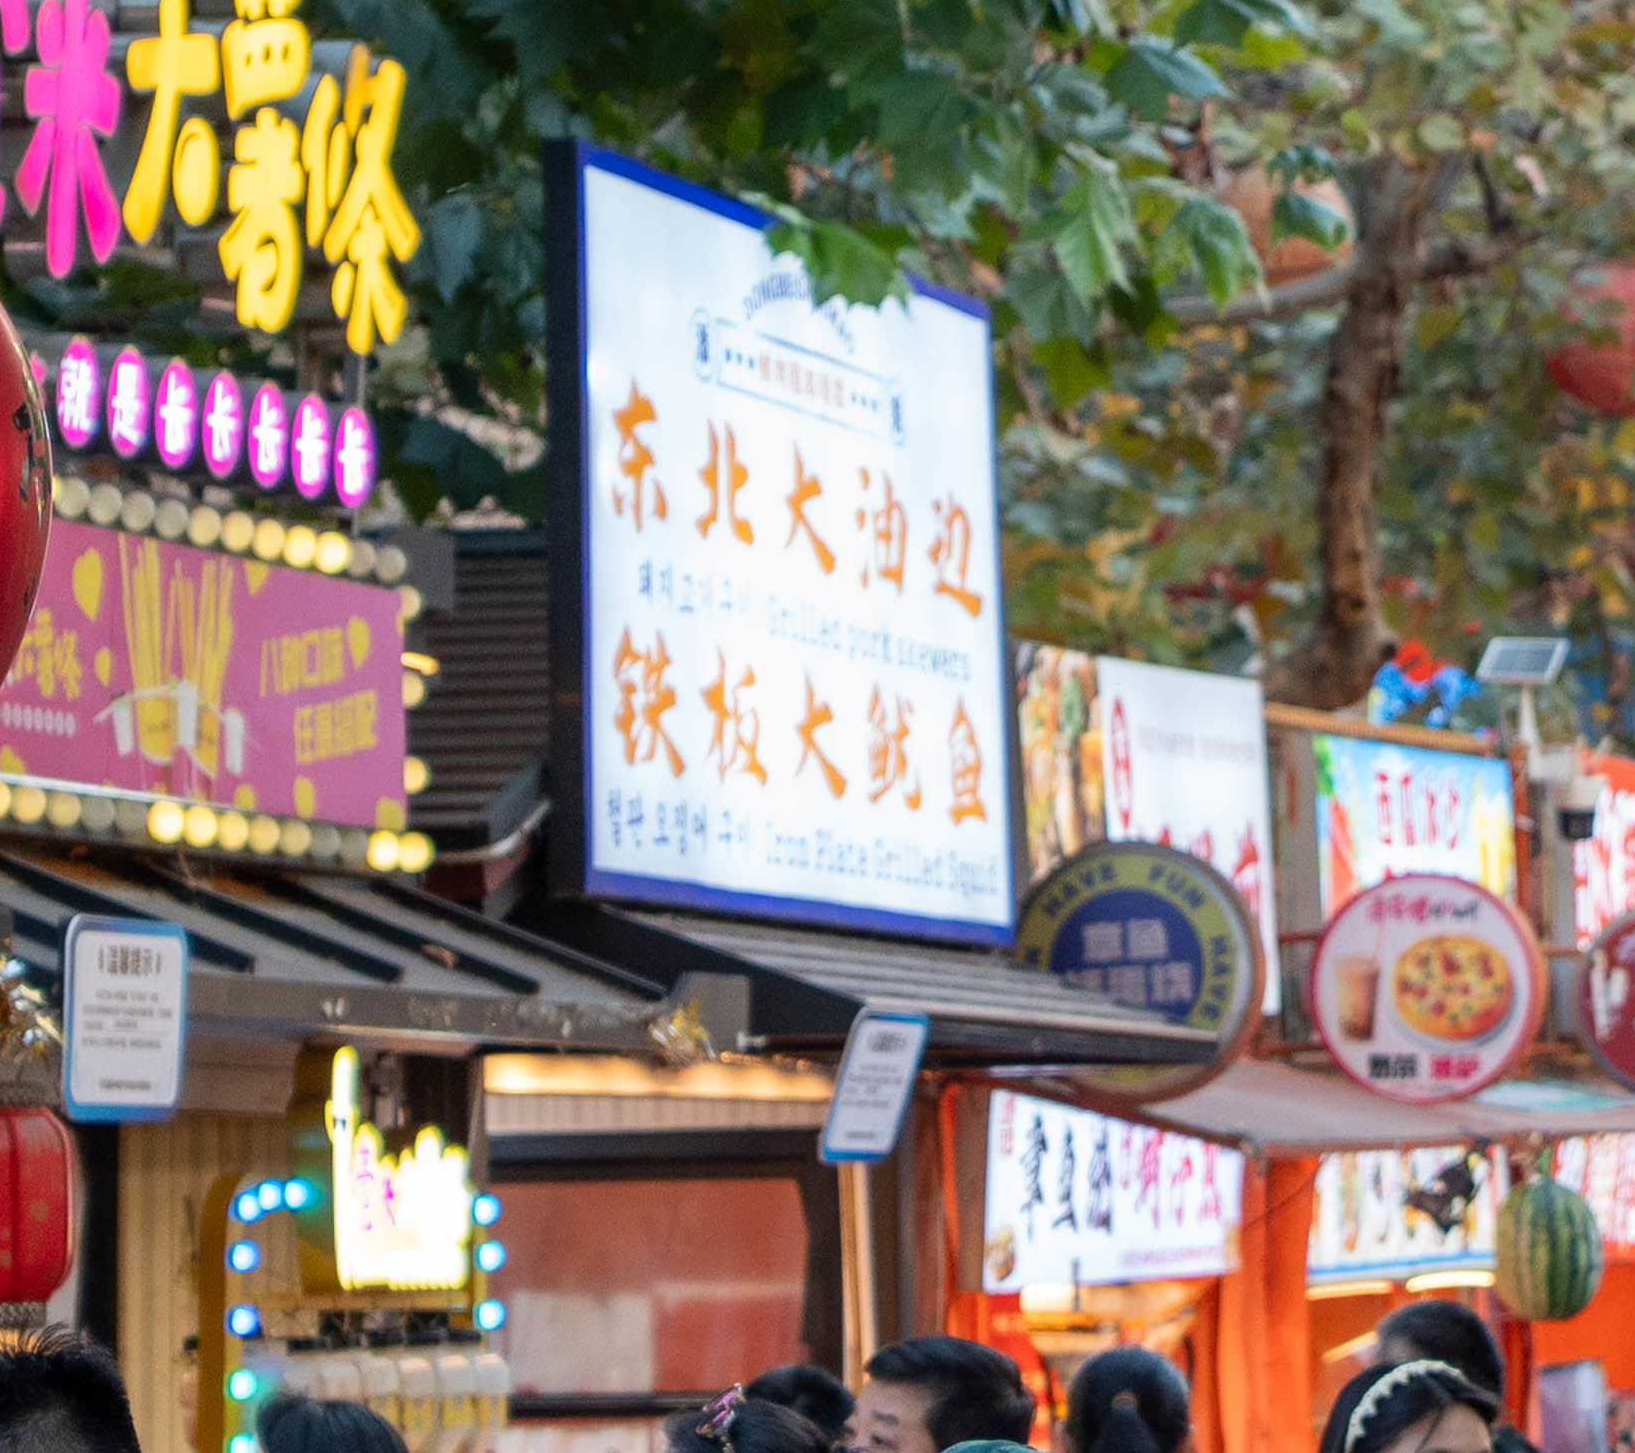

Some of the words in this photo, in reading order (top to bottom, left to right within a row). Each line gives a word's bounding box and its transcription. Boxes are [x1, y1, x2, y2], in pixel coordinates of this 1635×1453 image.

[610, 377, 984, 619] 东北大油边
[609, 624, 987, 827] 铁板大鱿鱼
[1146, 863, 1204, 910] FUN
